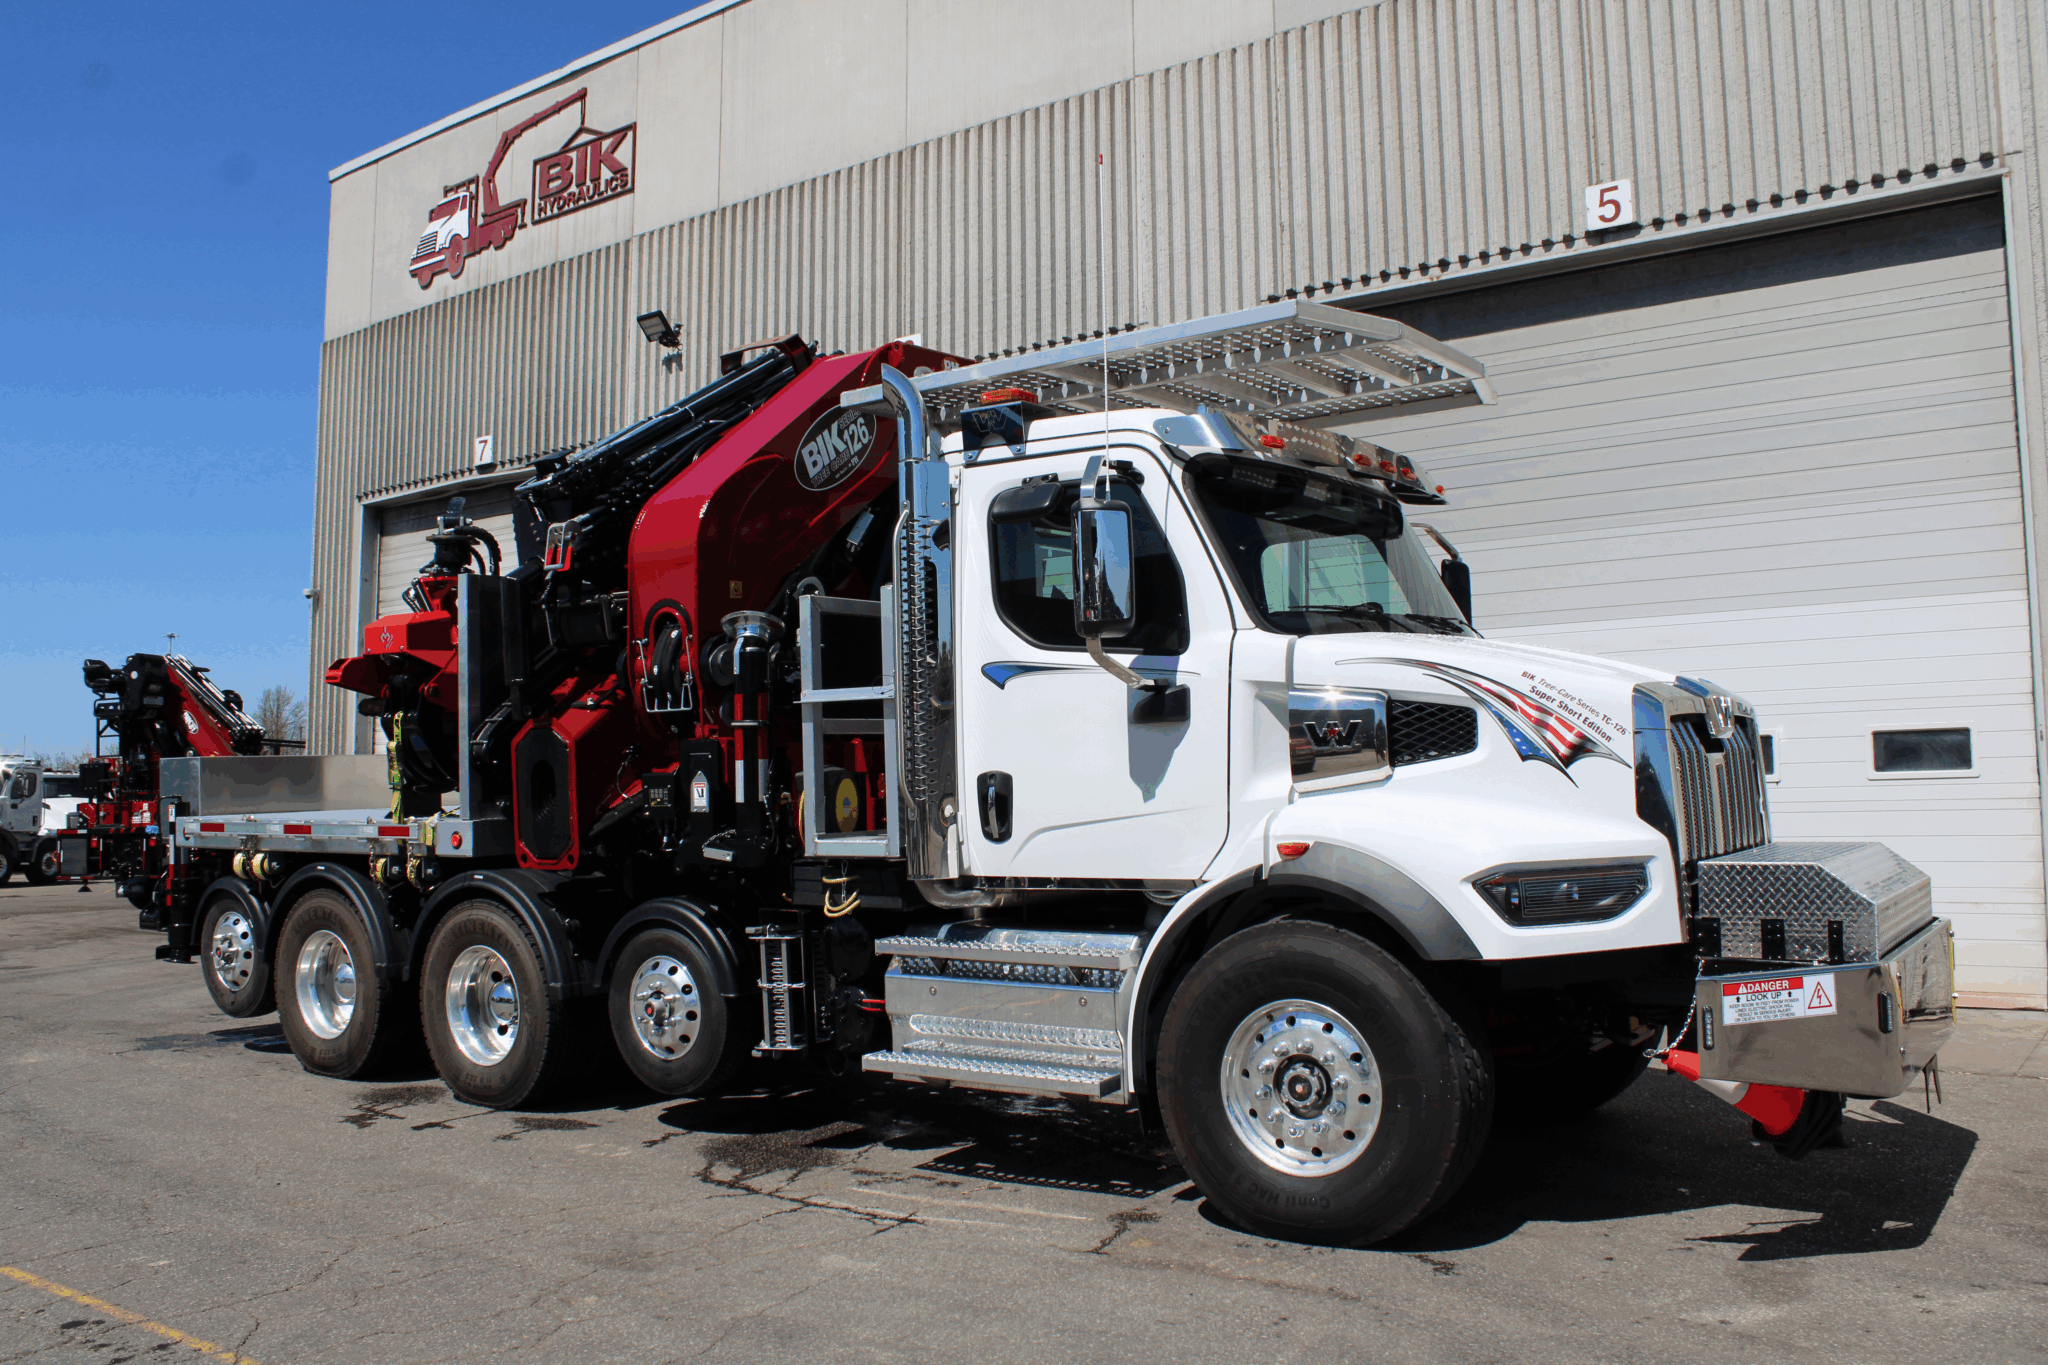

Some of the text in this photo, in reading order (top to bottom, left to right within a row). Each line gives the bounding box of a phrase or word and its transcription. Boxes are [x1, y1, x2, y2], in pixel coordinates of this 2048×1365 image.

[538, 131, 629, 200] BIK
[538, 169, 629, 218] HYDRAULICS
[1598, 185, 1621, 223] 5
[479, 439, 488, 462] 7
[801, 417, 869, 479] BIK 126
[811, 466, 831, 488] TREE
[830, 449, 851, 472] CARE
[1521, 670, 1537, 682] BIK
[1538, 678, 1577, 702] Tree-Care
[1576, 698, 1600, 718] Series
[1557, 700, 1583, 720] Short
[1746, 991, 1782, 1002] LOOK UP
[1747, 980, 1790, 992] DANGER
[1246, 1181, 1280, 1204] HAC
[1284, 1194, 1331, 1210] Conti
